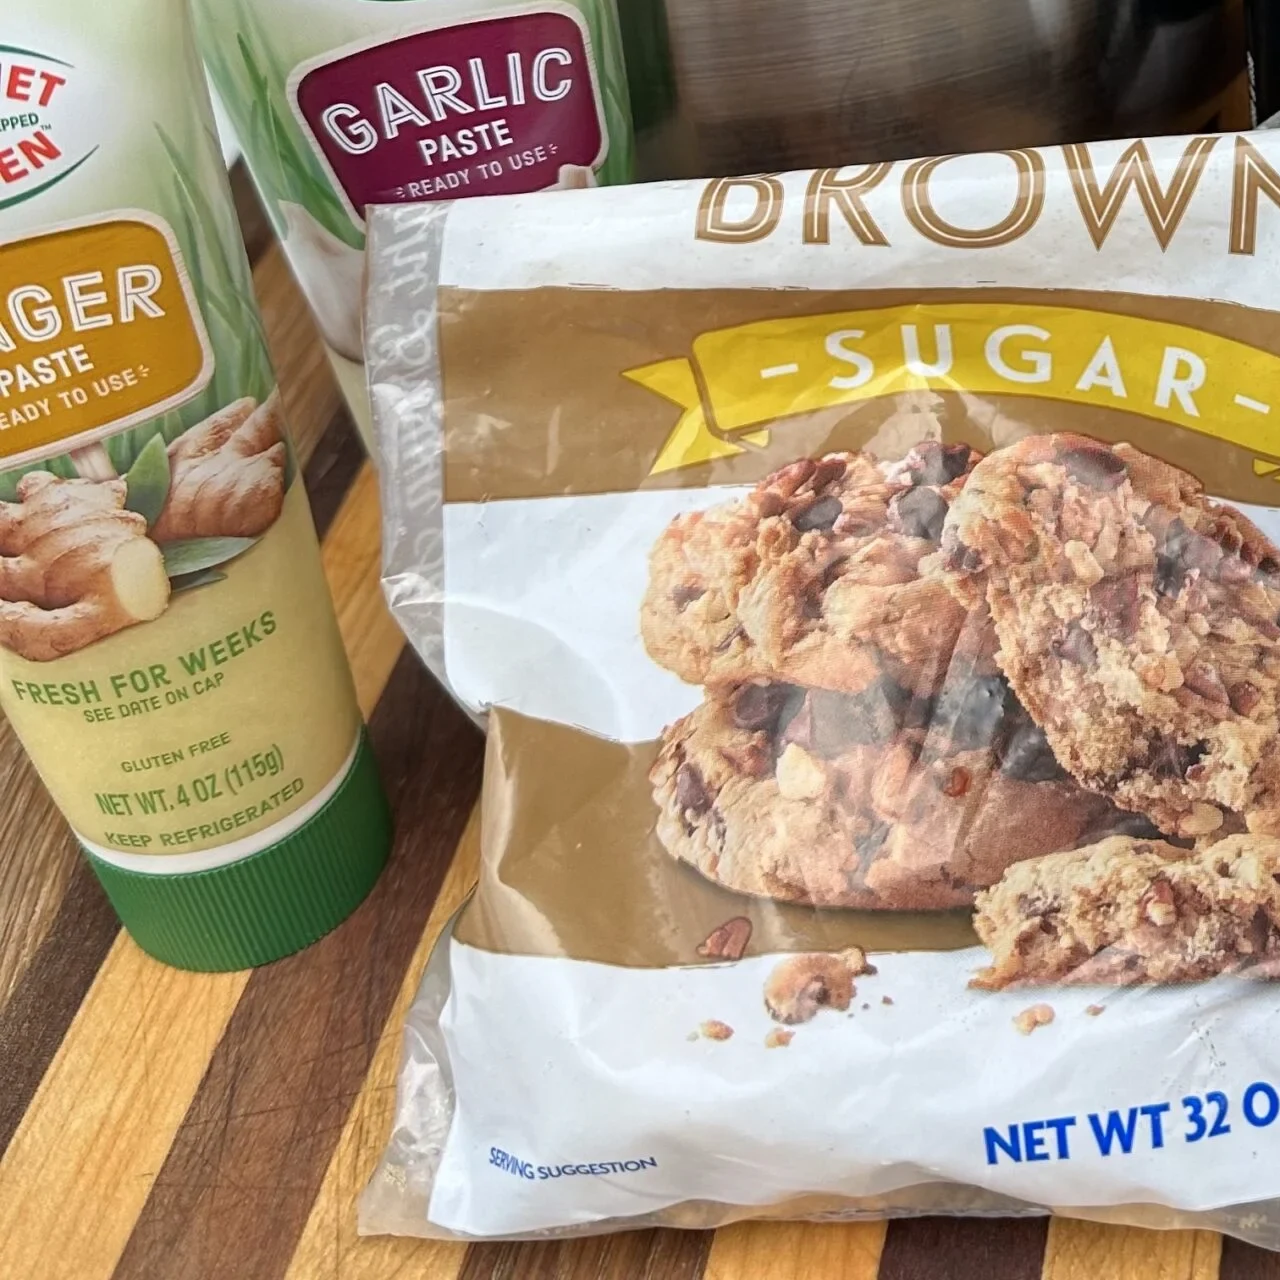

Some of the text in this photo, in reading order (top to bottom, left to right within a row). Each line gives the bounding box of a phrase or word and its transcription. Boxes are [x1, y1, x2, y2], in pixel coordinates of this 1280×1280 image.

[322, 47, 573, 155] GARLIC
[418, 119, 514, 166] PASTE
[408, 146, 548, 198] READY TO USE
[0, 264, 166, 353] GER
[0, 344, 94, 398] PASTE
[57, 384, 88, 409] TO
[93, 368, 138, 397] USE
[11, 610, 278, 706] FRESH FOR WEEKS
[83, 671, 225, 724] SEE DATE ON CAP
[120, 731, 232, 774] GLUTEN FREE
[94, 743, 286, 818] NET WT. 4 OZ (115g)
[104, 776, 305, 848] KEEP REFRIGERATED
[983, 1116, 1076, 1165] NET
[1089, 1101, 1170, 1157] WT
[1182, 1091, 1232, 1144] 32
[488, 1146, 659, 1180] SERVING SUGGESTION
